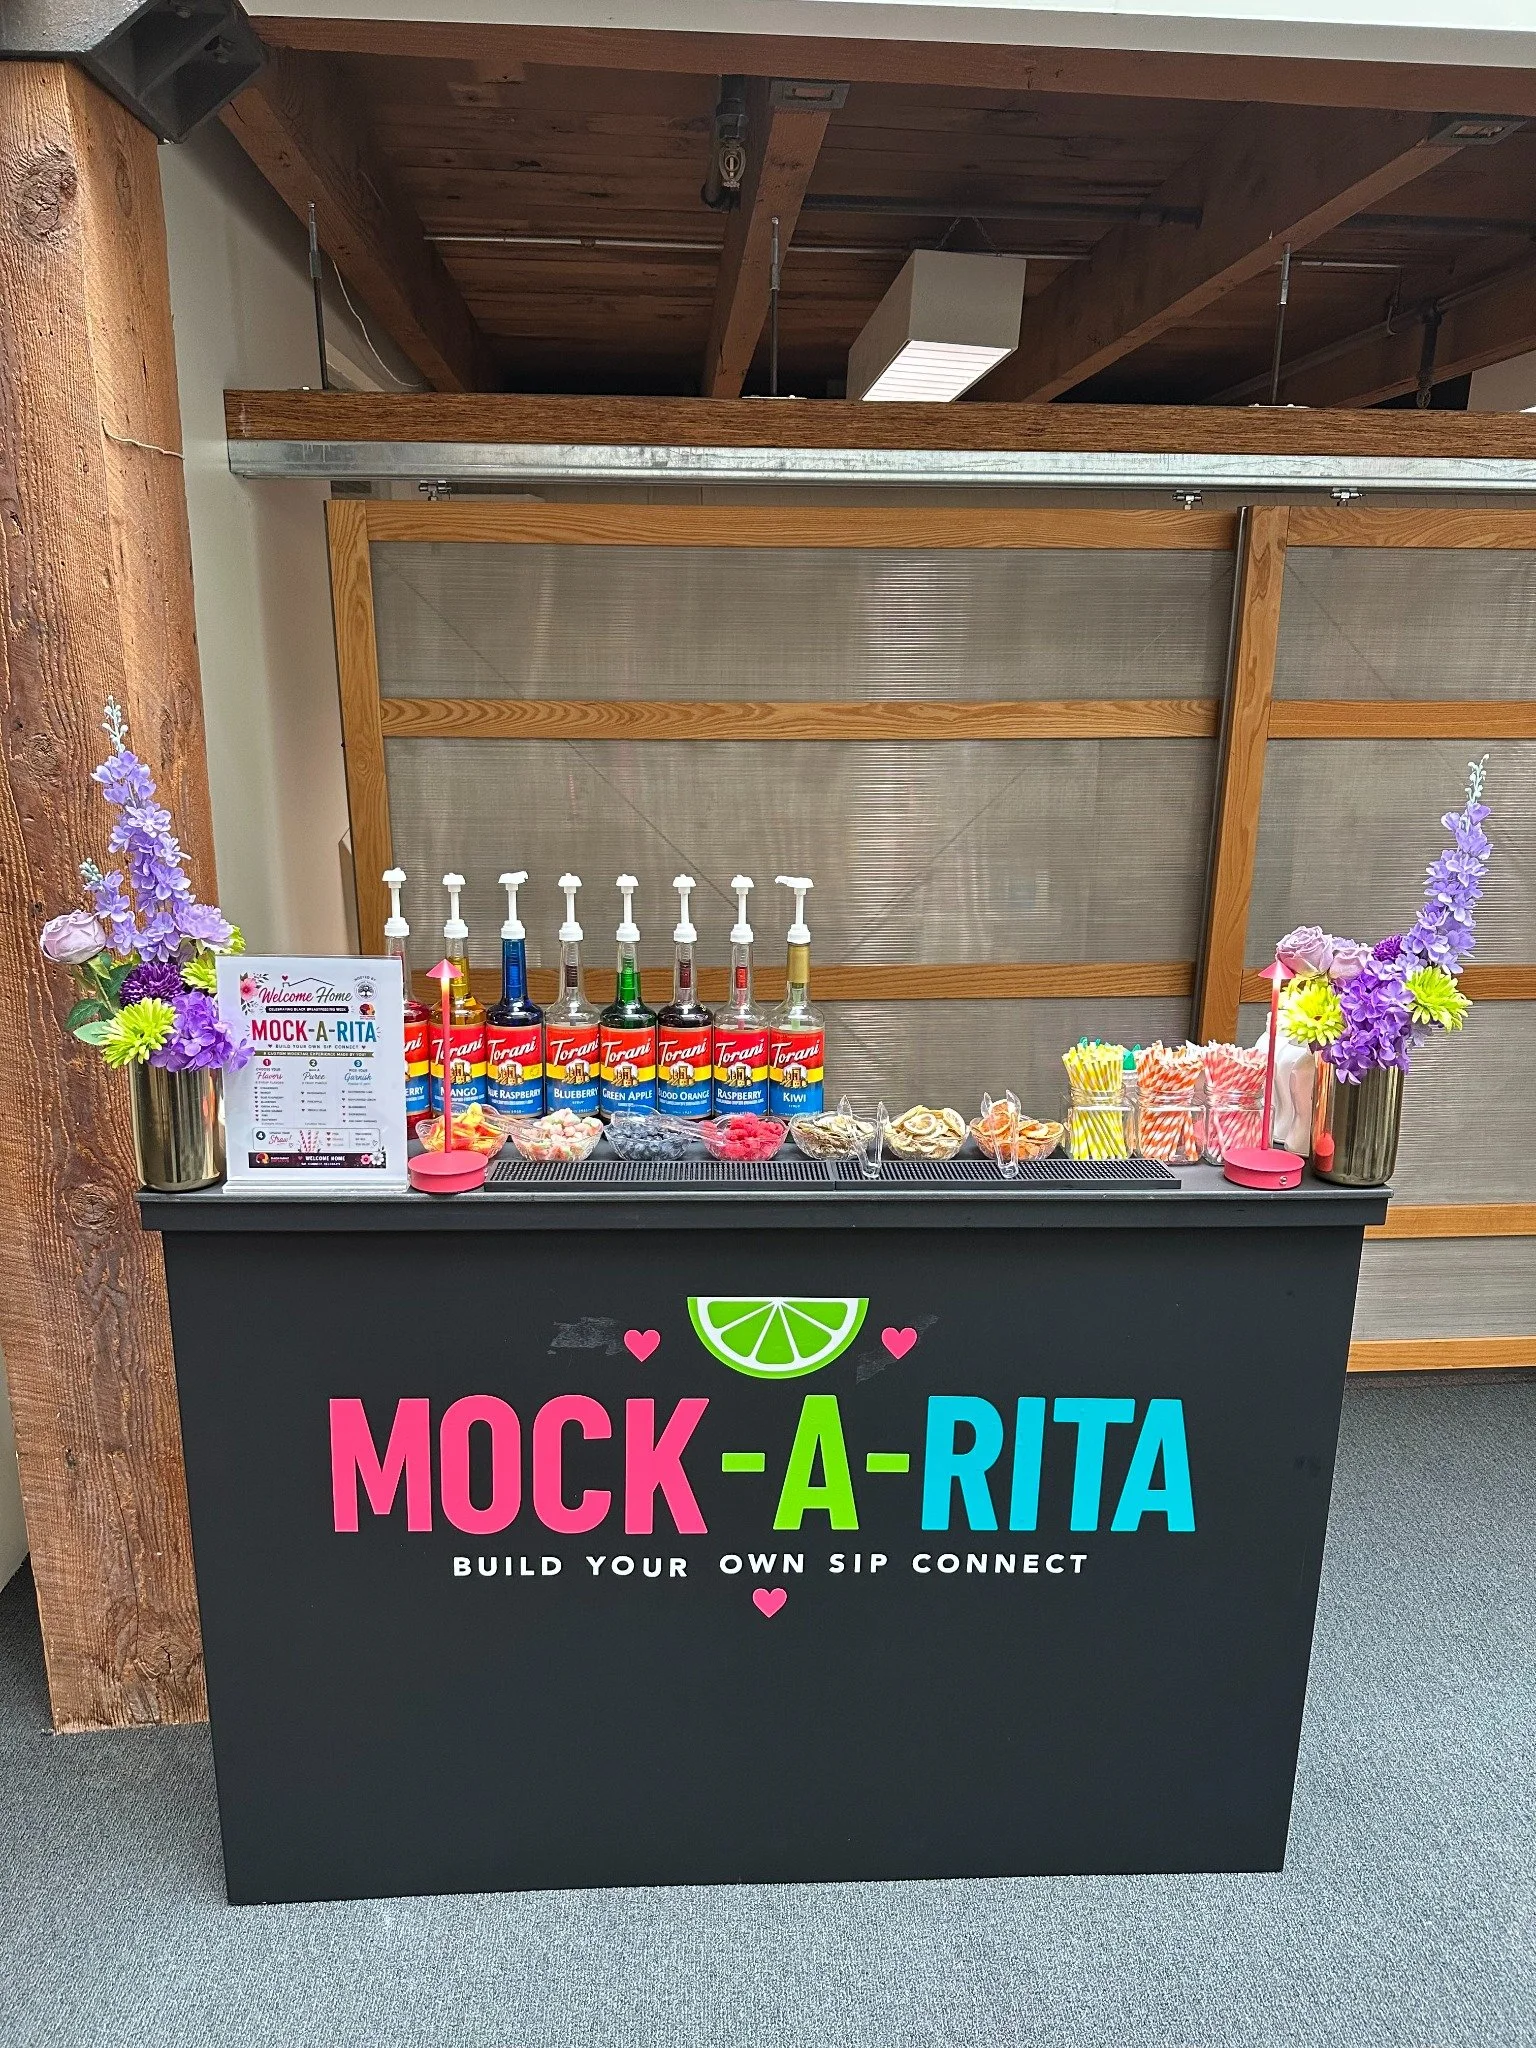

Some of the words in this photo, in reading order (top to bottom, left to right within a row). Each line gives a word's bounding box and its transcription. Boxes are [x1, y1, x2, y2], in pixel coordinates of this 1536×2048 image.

[258, 987, 313, 1004] Welcome
[315, 986, 353, 1004] Home
[251, 1019, 377, 1043] MOCK-A-RITA
[487, 1036, 538, 1066] Torani
[549, 1033, 600, 1067] Torani
[601, 1037, 652, 1068] Torani
[658, 1037, 708, 1068] Torani
[715, 1038, 765, 1069] Torani
[771, 1039, 820, 1070] Torani
[256, 1071, 283, 1080] Flavors
[344, 1072, 373, 1083] Garnish
[499, 1088, 541, 1099] RASPBERRY
[553, 1086, 599, 1099] BLUEBERRY
[602, 1087, 626, 1101] GREEN
[627, 1089, 653, 1101] APPLE
[680, 1090, 710, 1101] ORANGE
[717, 1087, 762, 1101] RASPBERRY
[783, 1092, 807, 1103] KIWI
[268, 1134, 293, 1145] Straw!
[329, 1394, 1196, 1535] MOCK-A-RITA
[453, 1556, 562, 1577] BUILD
[585, 1555, 688, 1578] YOUR
[719, 1553, 804, 1575] OWN
[828, 1553, 888, 1574] SIP
[912, 1553, 1088, 1574] CONNECT
